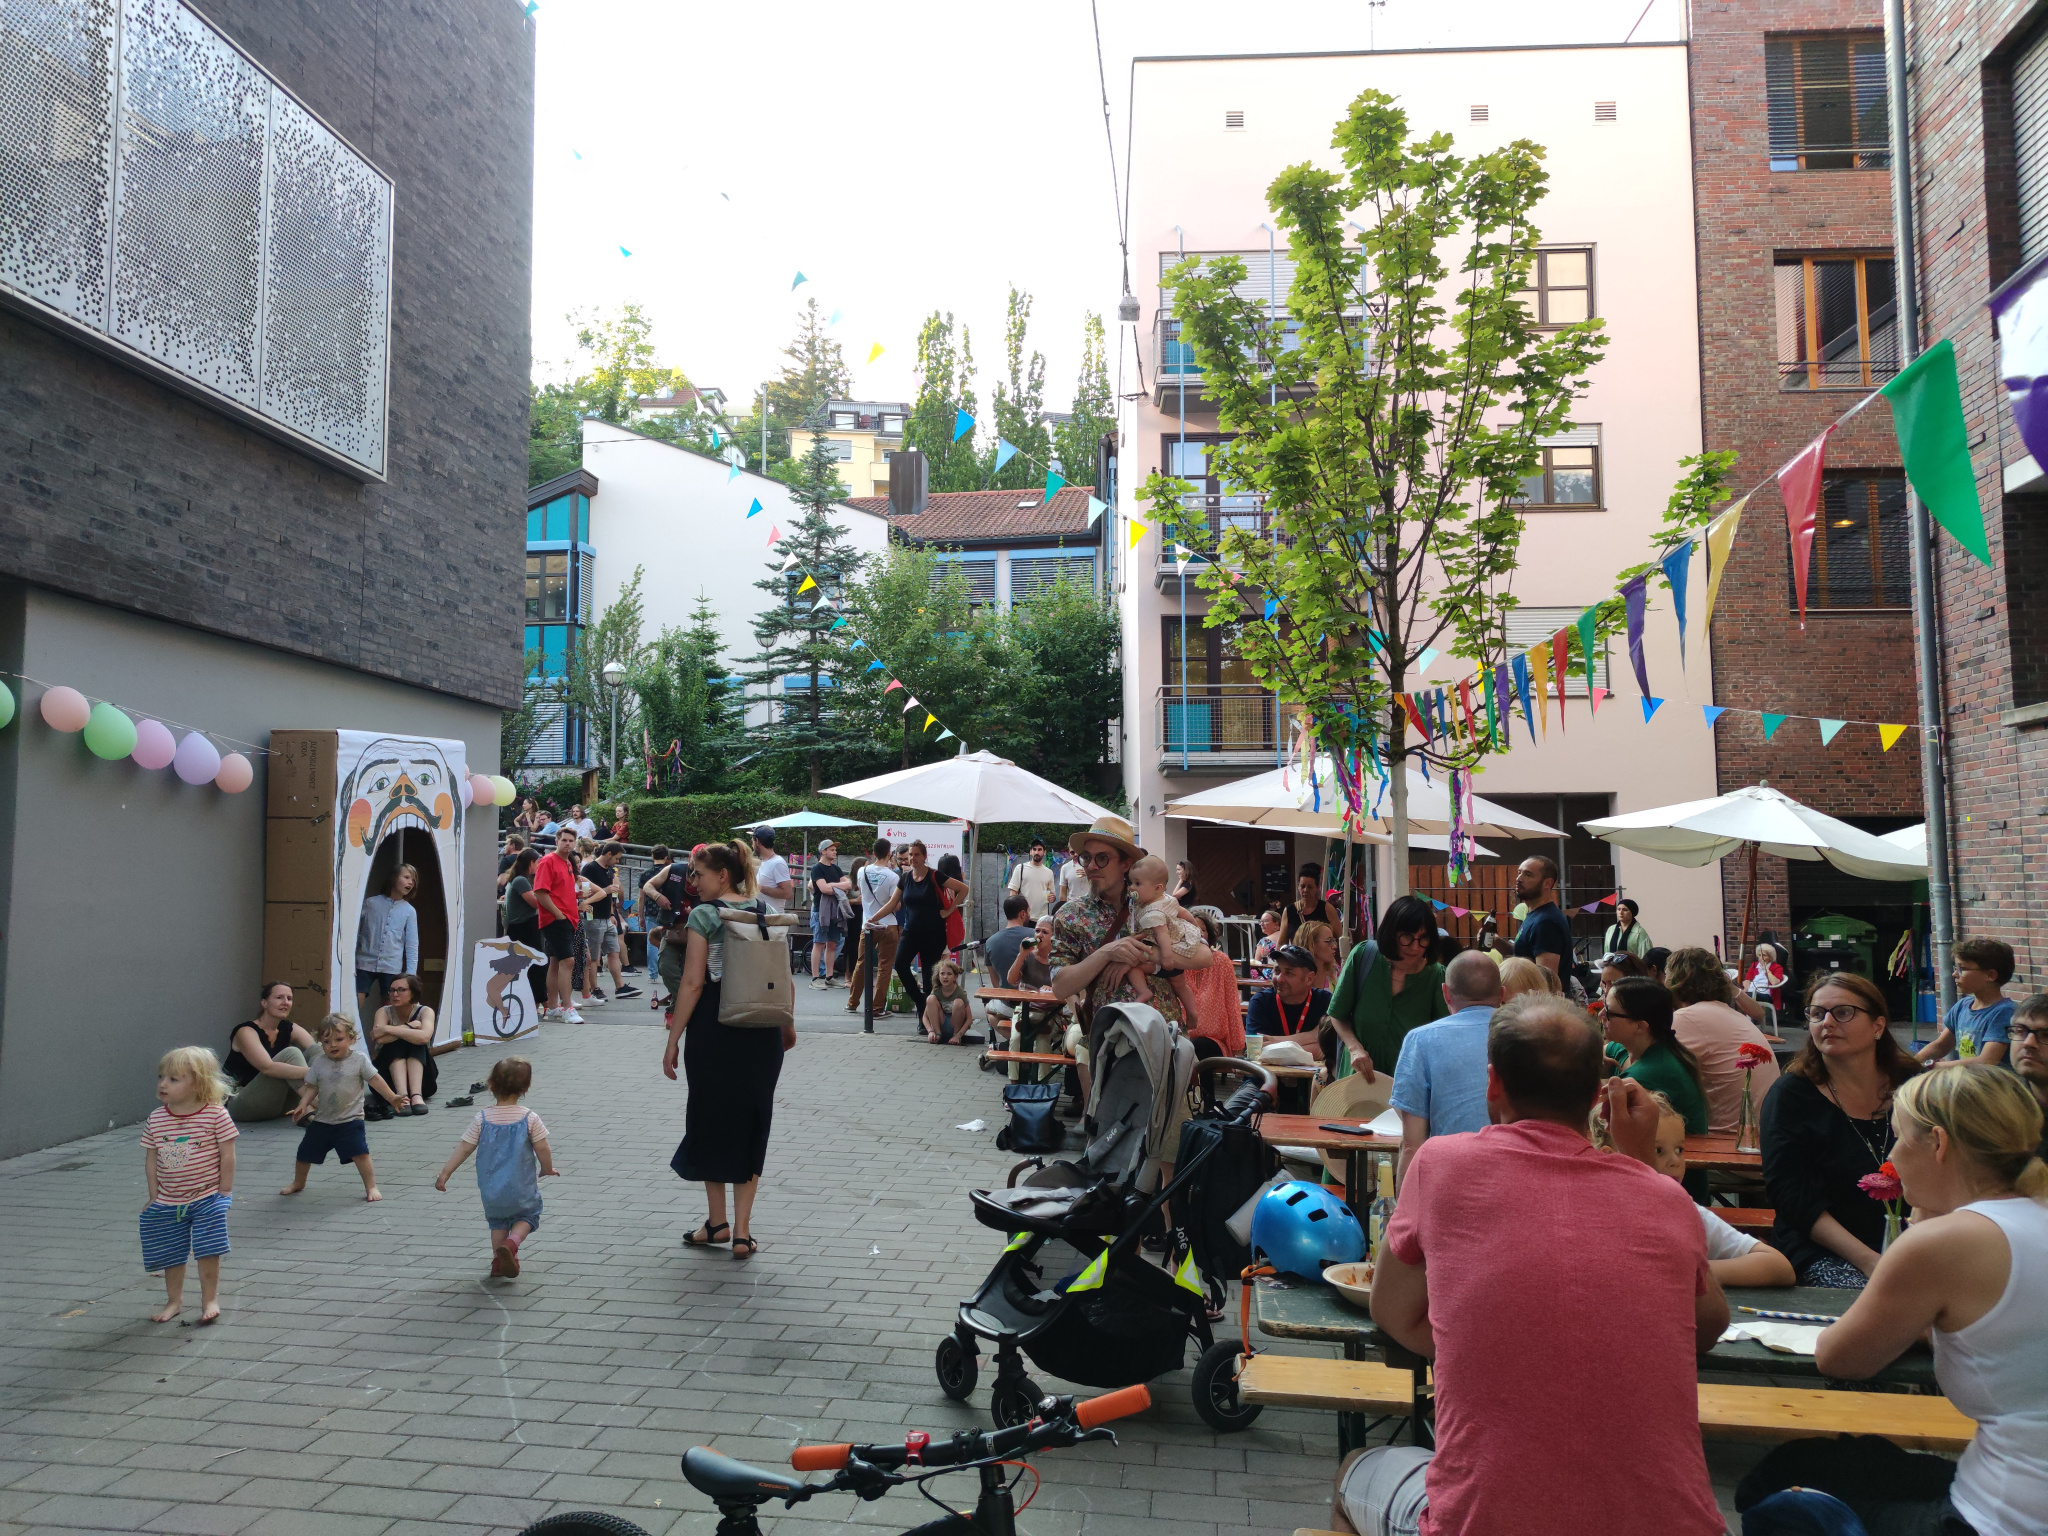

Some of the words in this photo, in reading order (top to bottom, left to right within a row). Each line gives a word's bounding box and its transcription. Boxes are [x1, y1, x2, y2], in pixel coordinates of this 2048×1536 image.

[1150, 805, 1156, 816] 9
[1106, 1127, 1118, 1142] Joie
[1176, 1226, 1189, 1249] Joie
